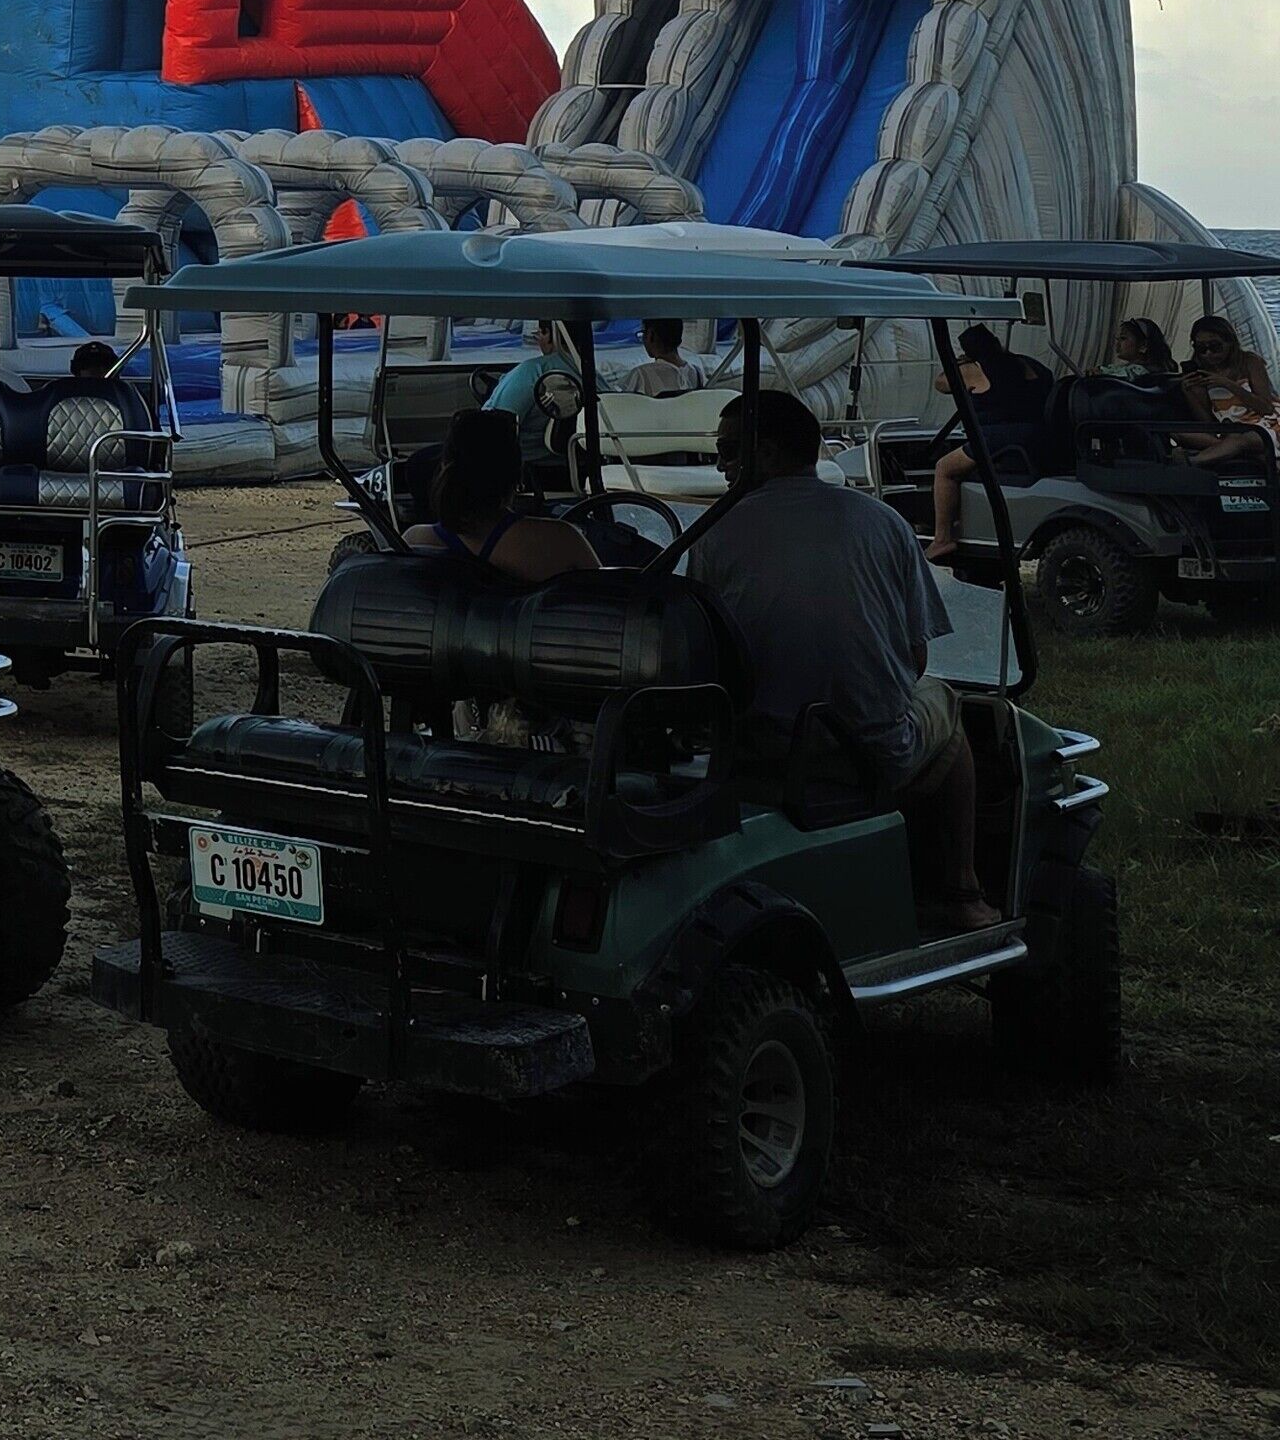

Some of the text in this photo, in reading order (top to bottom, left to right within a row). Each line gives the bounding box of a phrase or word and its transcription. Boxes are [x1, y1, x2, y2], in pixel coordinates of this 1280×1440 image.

[10, 553, 52, 571] 10402
[227, 835, 258, 847] BELIZE
[210, 853, 302, 899] C 10450
